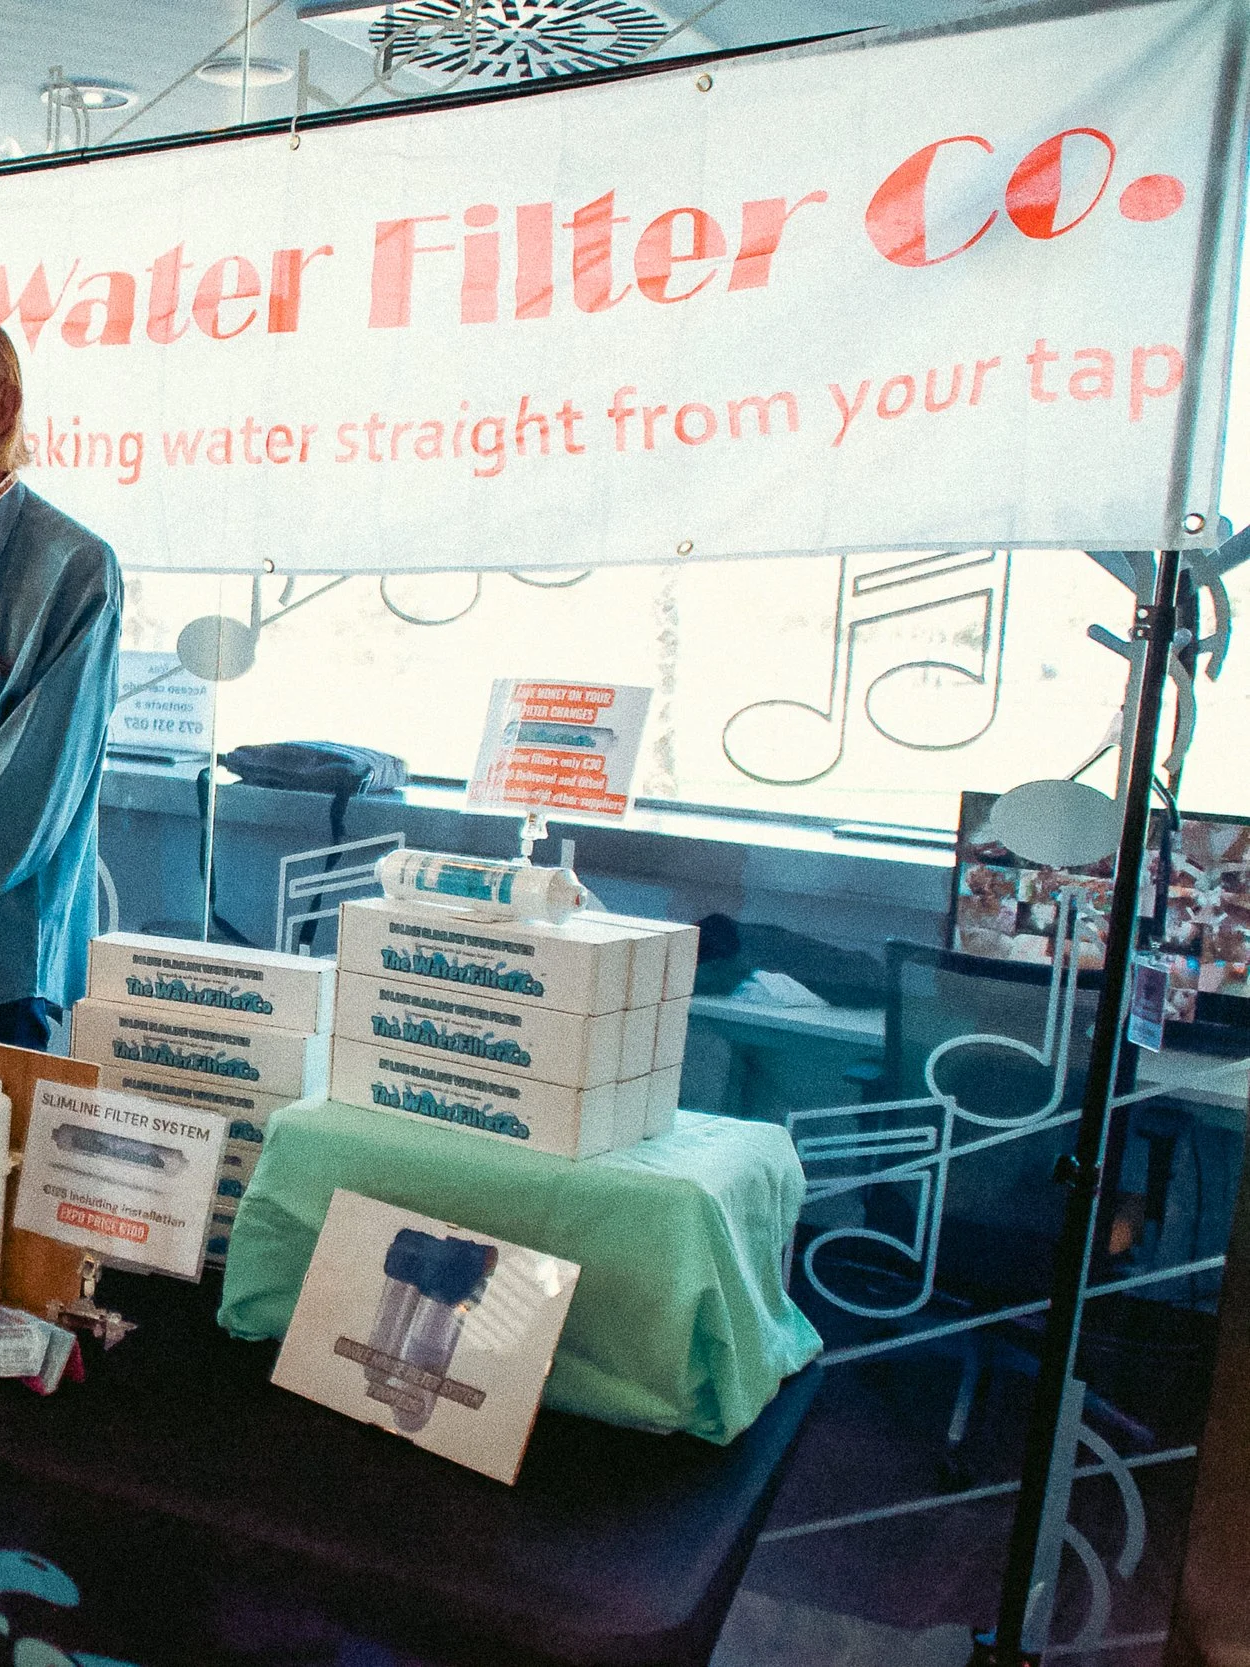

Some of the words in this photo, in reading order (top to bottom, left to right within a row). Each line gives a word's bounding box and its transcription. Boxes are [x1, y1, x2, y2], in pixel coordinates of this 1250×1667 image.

[368, 188, 828, 329] Filter
[865, 127, 1187, 268] Co.
[24, 415, 144, 486] nking
[161, 415, 318, 466] water
[334, 395, 586, 477] straight
[607, 385, 801, 452] from
[829, 355, 1002, 447] your
[1026, 338, 1185, 423] tap
[550, 705, 594, 720] CHANGES
[381, 949, 411, 972] The
[413, 952, 459, 980] Water
[126, 977, 154, 997] The
[155, 981, 203, 1004] Water
[371, 1016, 401, 1039] The
[403, 1020, 450, 1049] Water
[112, 1040, 140, 1061] The
[141, 1044, 189, 1068] Water
[371, 1083, 401, 1107] The
[403, 1088, 450, 1118] Water
[42, 1093, 101, 1118] SLIMLINE
[104, 1107, 148, 1129] FILTER
[153, 1118, 210, 1142] SYSTEM
[121, 1203, 186, 1228] installation
